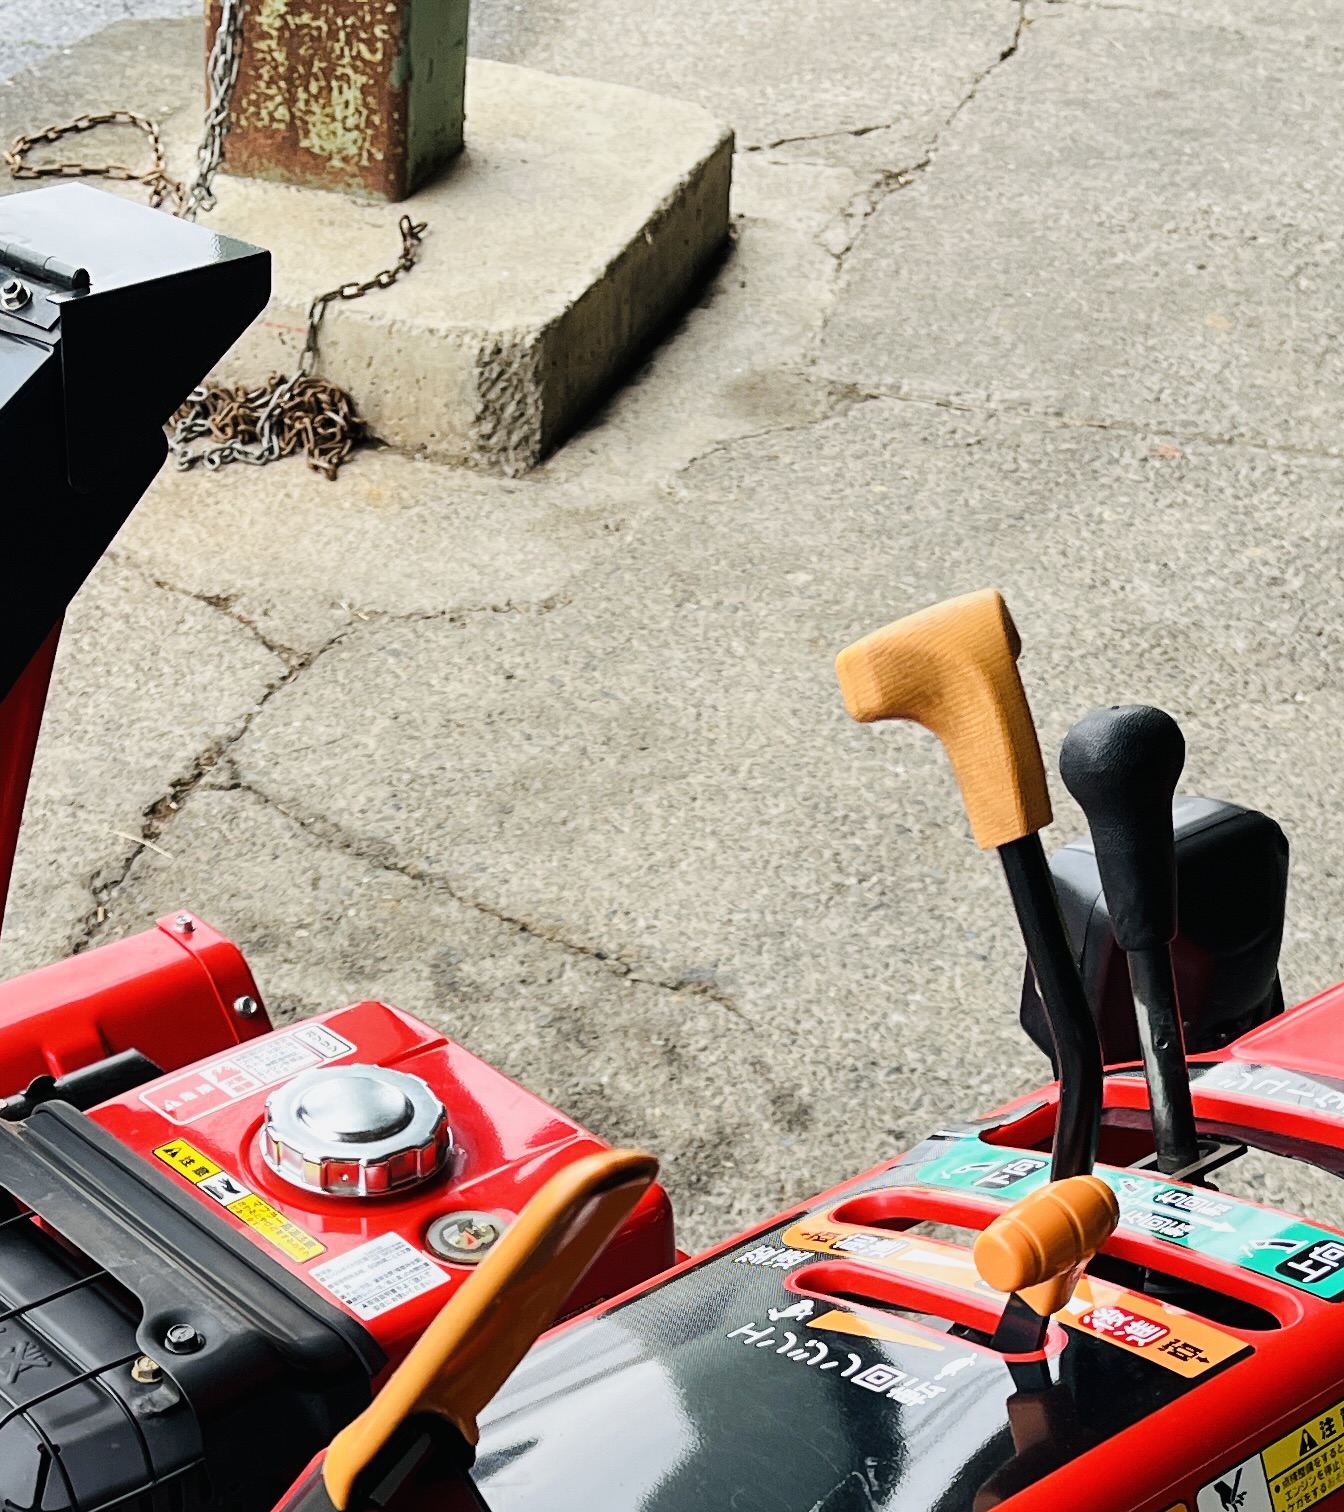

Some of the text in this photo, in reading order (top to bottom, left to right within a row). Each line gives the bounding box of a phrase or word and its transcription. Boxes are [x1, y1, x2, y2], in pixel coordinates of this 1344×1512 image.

[1082, 1306, 1167, 1347] 後進
[726, 1322, 947, 1406] エンジン回転
